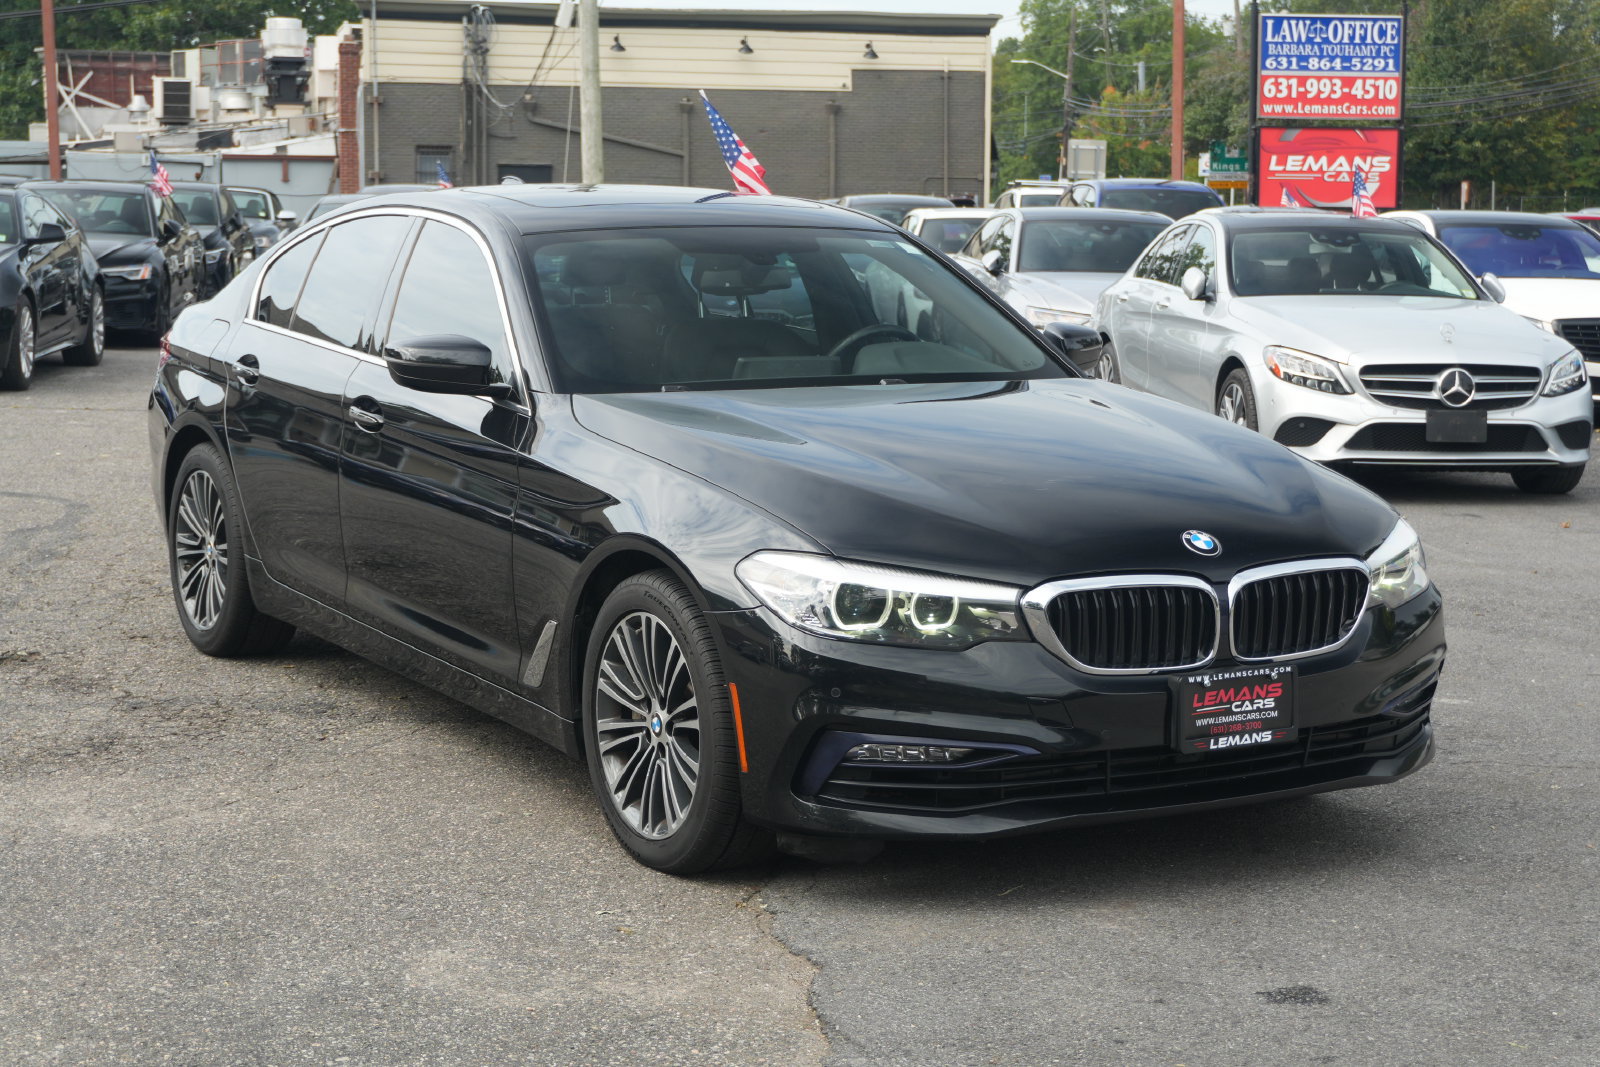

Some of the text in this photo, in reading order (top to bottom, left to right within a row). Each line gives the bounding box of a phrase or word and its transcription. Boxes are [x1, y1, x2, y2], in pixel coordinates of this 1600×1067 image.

[1265, 19, 1399, 44] LAW OFFICE
[1268, 43, 1395, 57] BARBARA TOUHAMY PC
[1265, 57, 1396, 71] 631-864-5291
[1263, 78, 1398, 100] 631-993-4510
[1263, 102, 1396, 115] www.LemansCars.com
[1212, 162, 1240, 172] Kings
[1268, 155, 1391, 172] LEMANS
[1188, 666, 1292, 683] WWW.LEMANSCARS.COM
[1192, 682, 1283, 708] LEMANS
[1231, 698, 1275, 712] CARS
[1195, 710, 1278, 727] WWW.LEMANSCARS.COM
[1209, 730, 1272, 749] LEMANS
